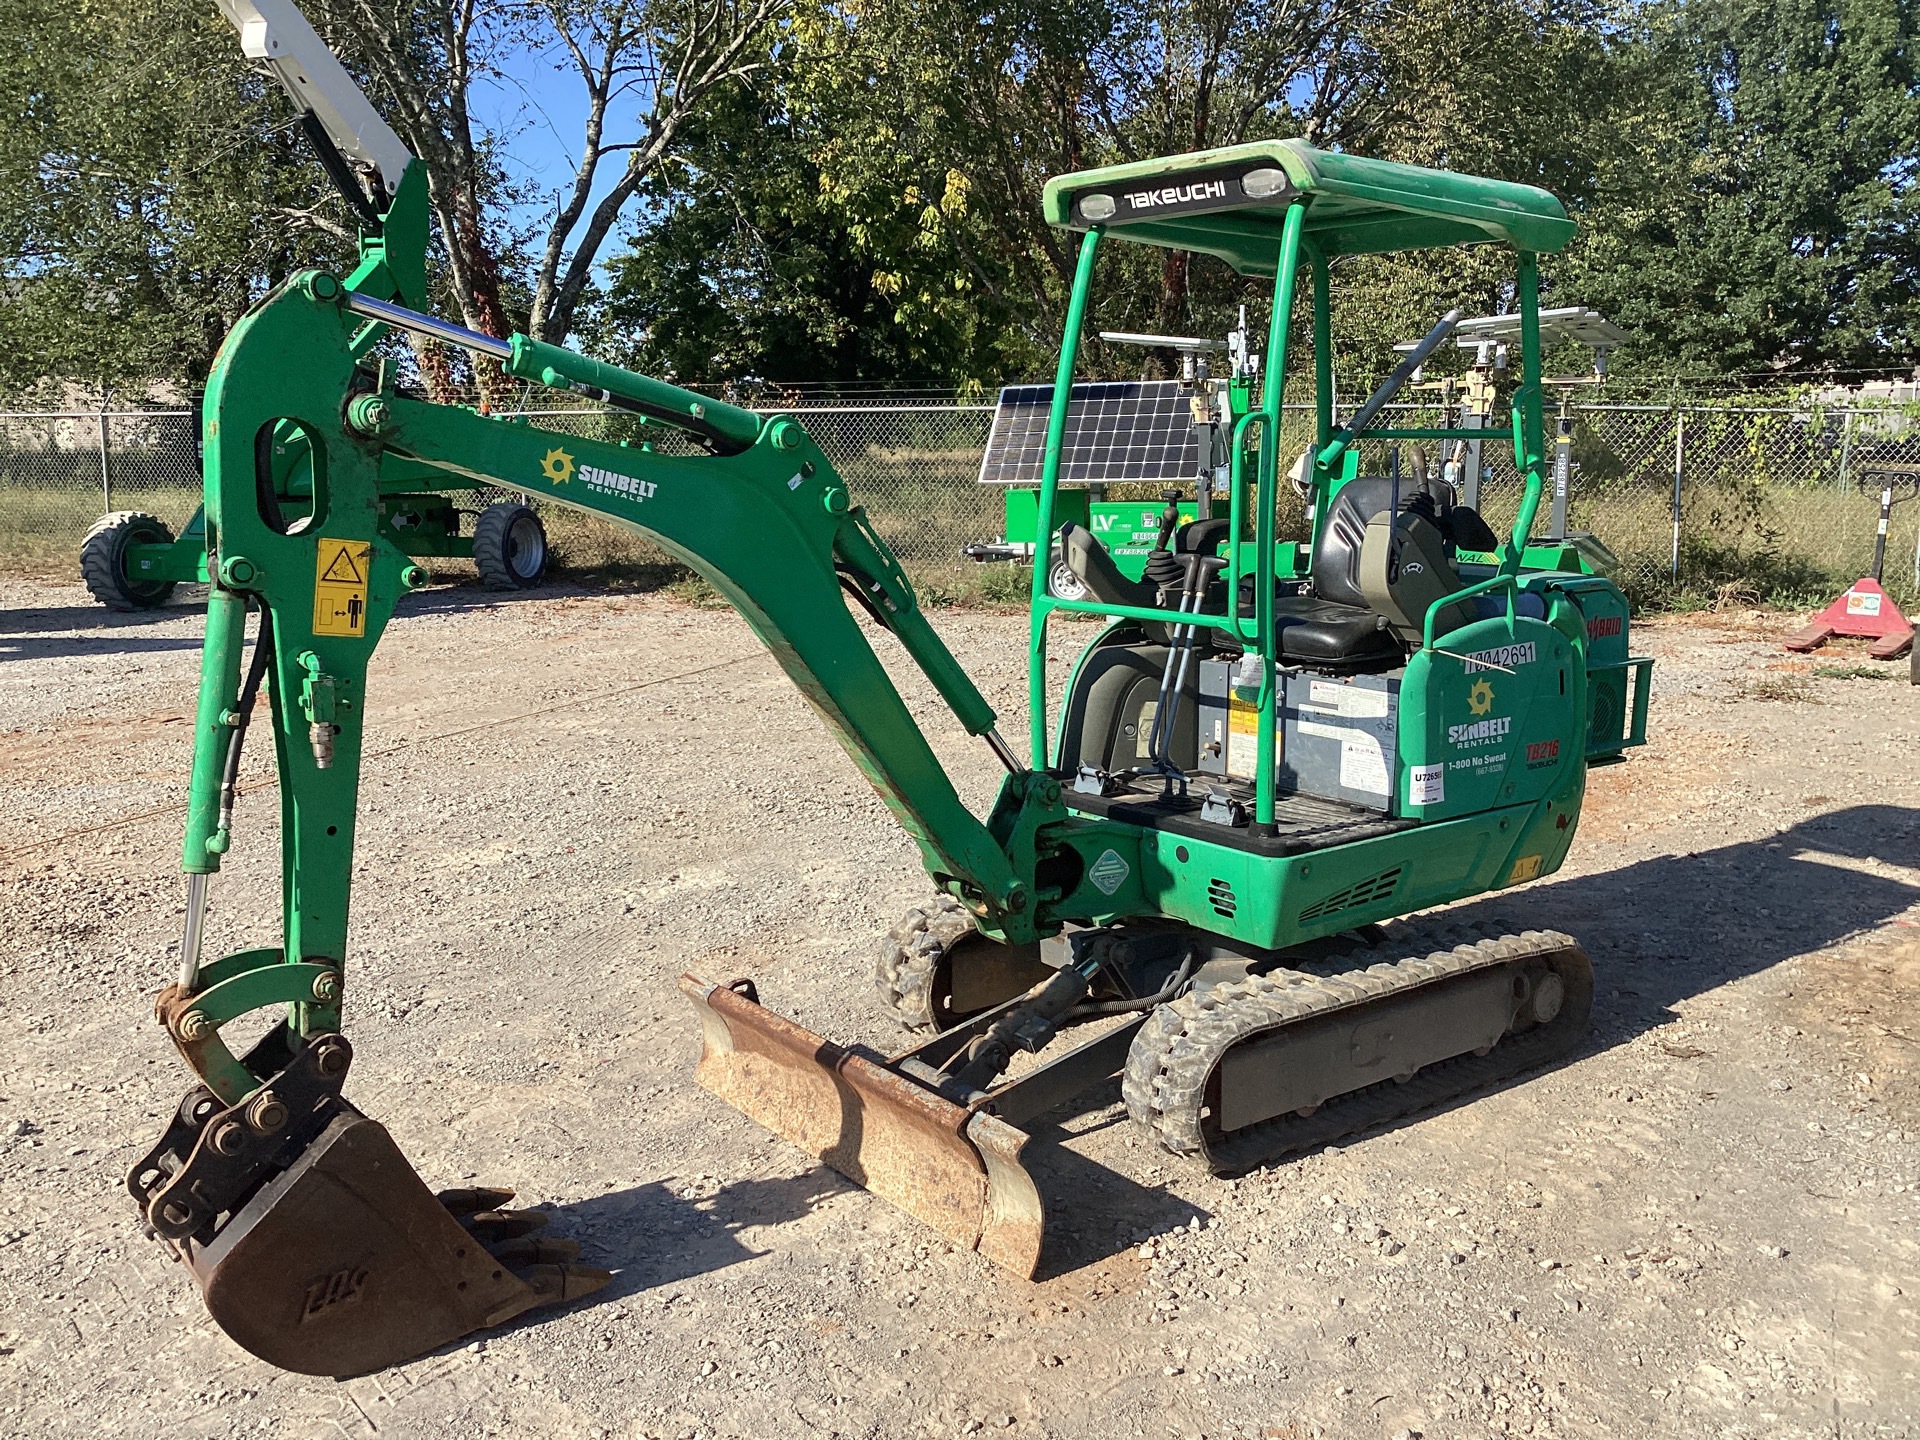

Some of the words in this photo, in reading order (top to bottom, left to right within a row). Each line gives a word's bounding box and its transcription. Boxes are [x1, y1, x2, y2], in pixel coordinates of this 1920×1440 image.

[1123, 180, 1226, 209] TAKEUCHI
[578, 464, 658, 498] SUNBELT
[587, 483, 643, 503] RENTALS
[1587, 615, 1621, 641] HYBRID
[1467, 643, 1534, 672] 10042691
[1448, 716, 1511, 743] SUNBELT
[1457, 736, 1503, 749] RENTALS
[1448, 759, 1471, 770] 1-800
[1472, 757, 1483, 766] No
[1484, 752, 1506, 764] Sweat
[1526, 739, 1559, 761] TB216
